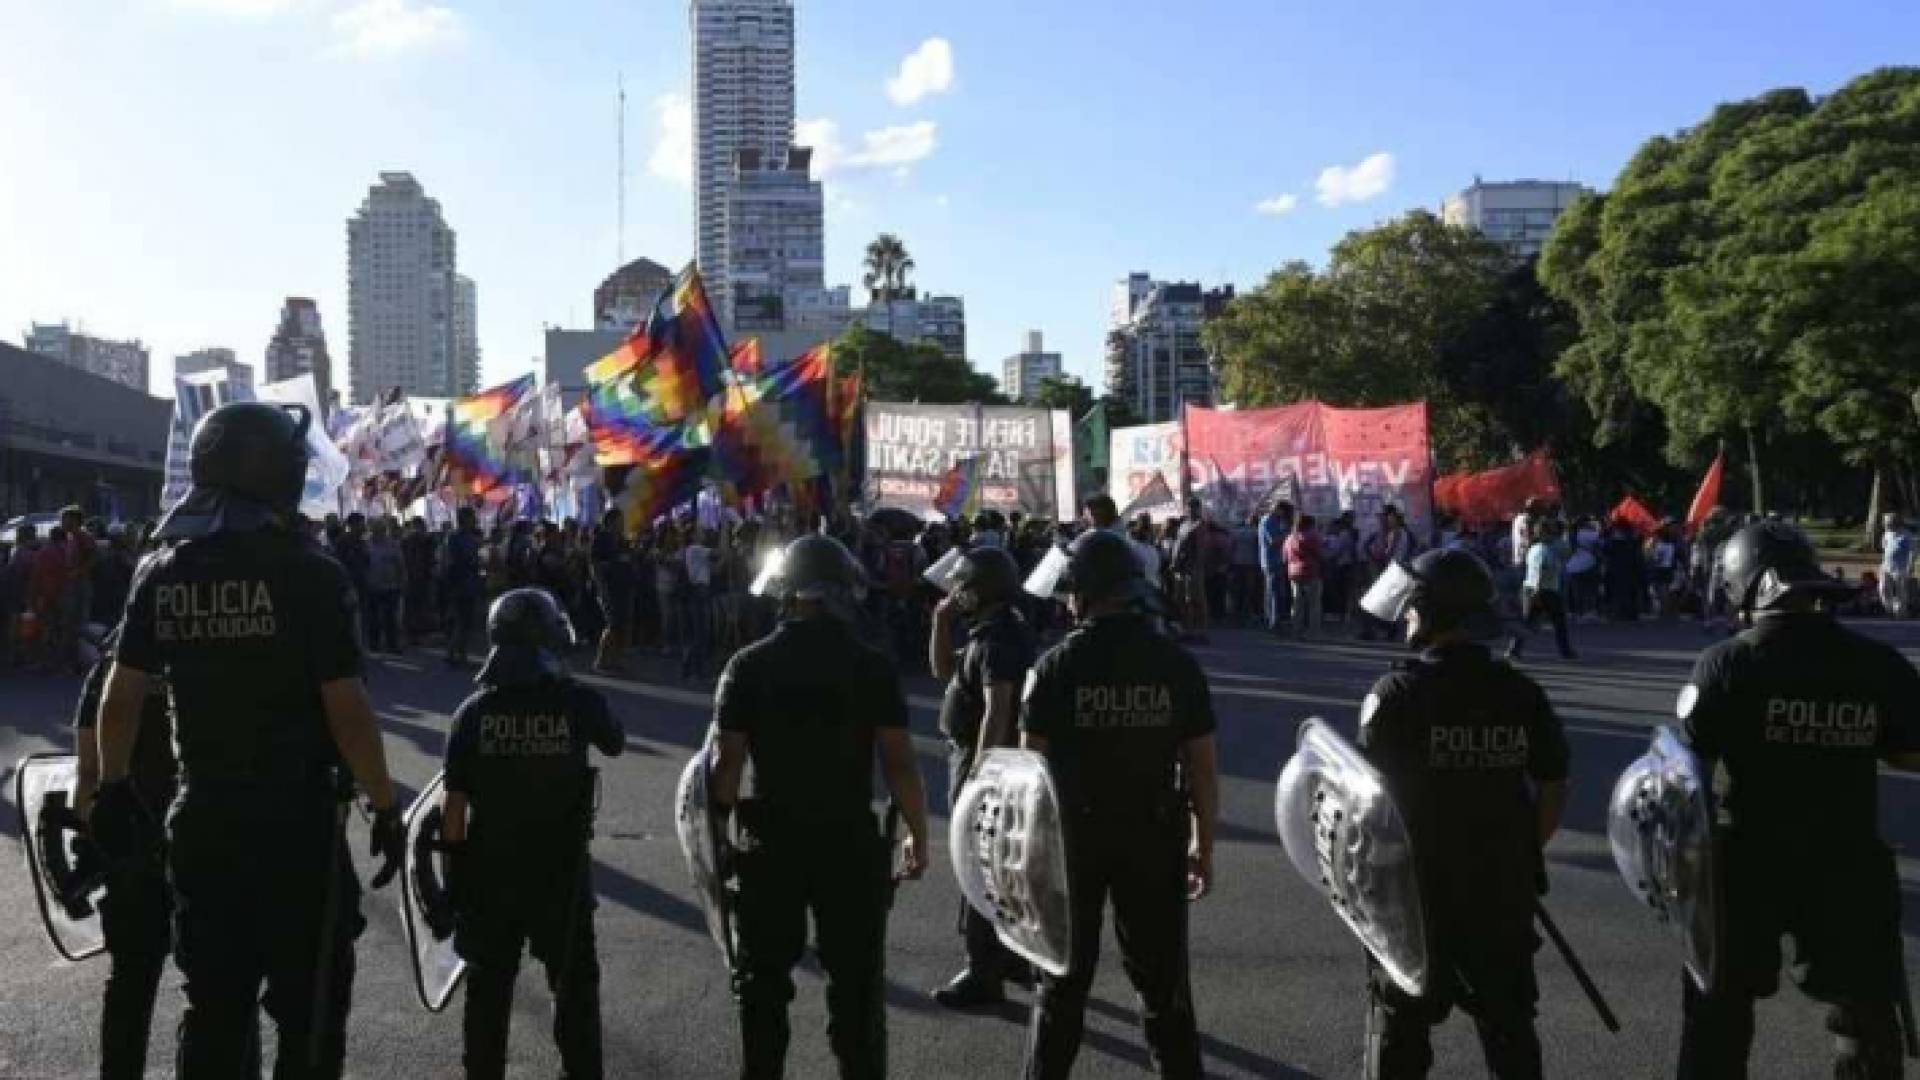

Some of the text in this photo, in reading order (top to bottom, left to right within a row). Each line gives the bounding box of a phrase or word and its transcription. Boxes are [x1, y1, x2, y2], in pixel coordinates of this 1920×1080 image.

[155, 580, 273, 617] POLICIA
[156, 620, 176, 640] DE
[207, 615, 276, 638] CIUDAD
[1075, 684, 1172, 712] POLICIA
[480, 714, 570, 739] POLICIA
[1767, 699, 1878, 729] POLICIA
[1431, 727, 1528, 754] POLICIA
